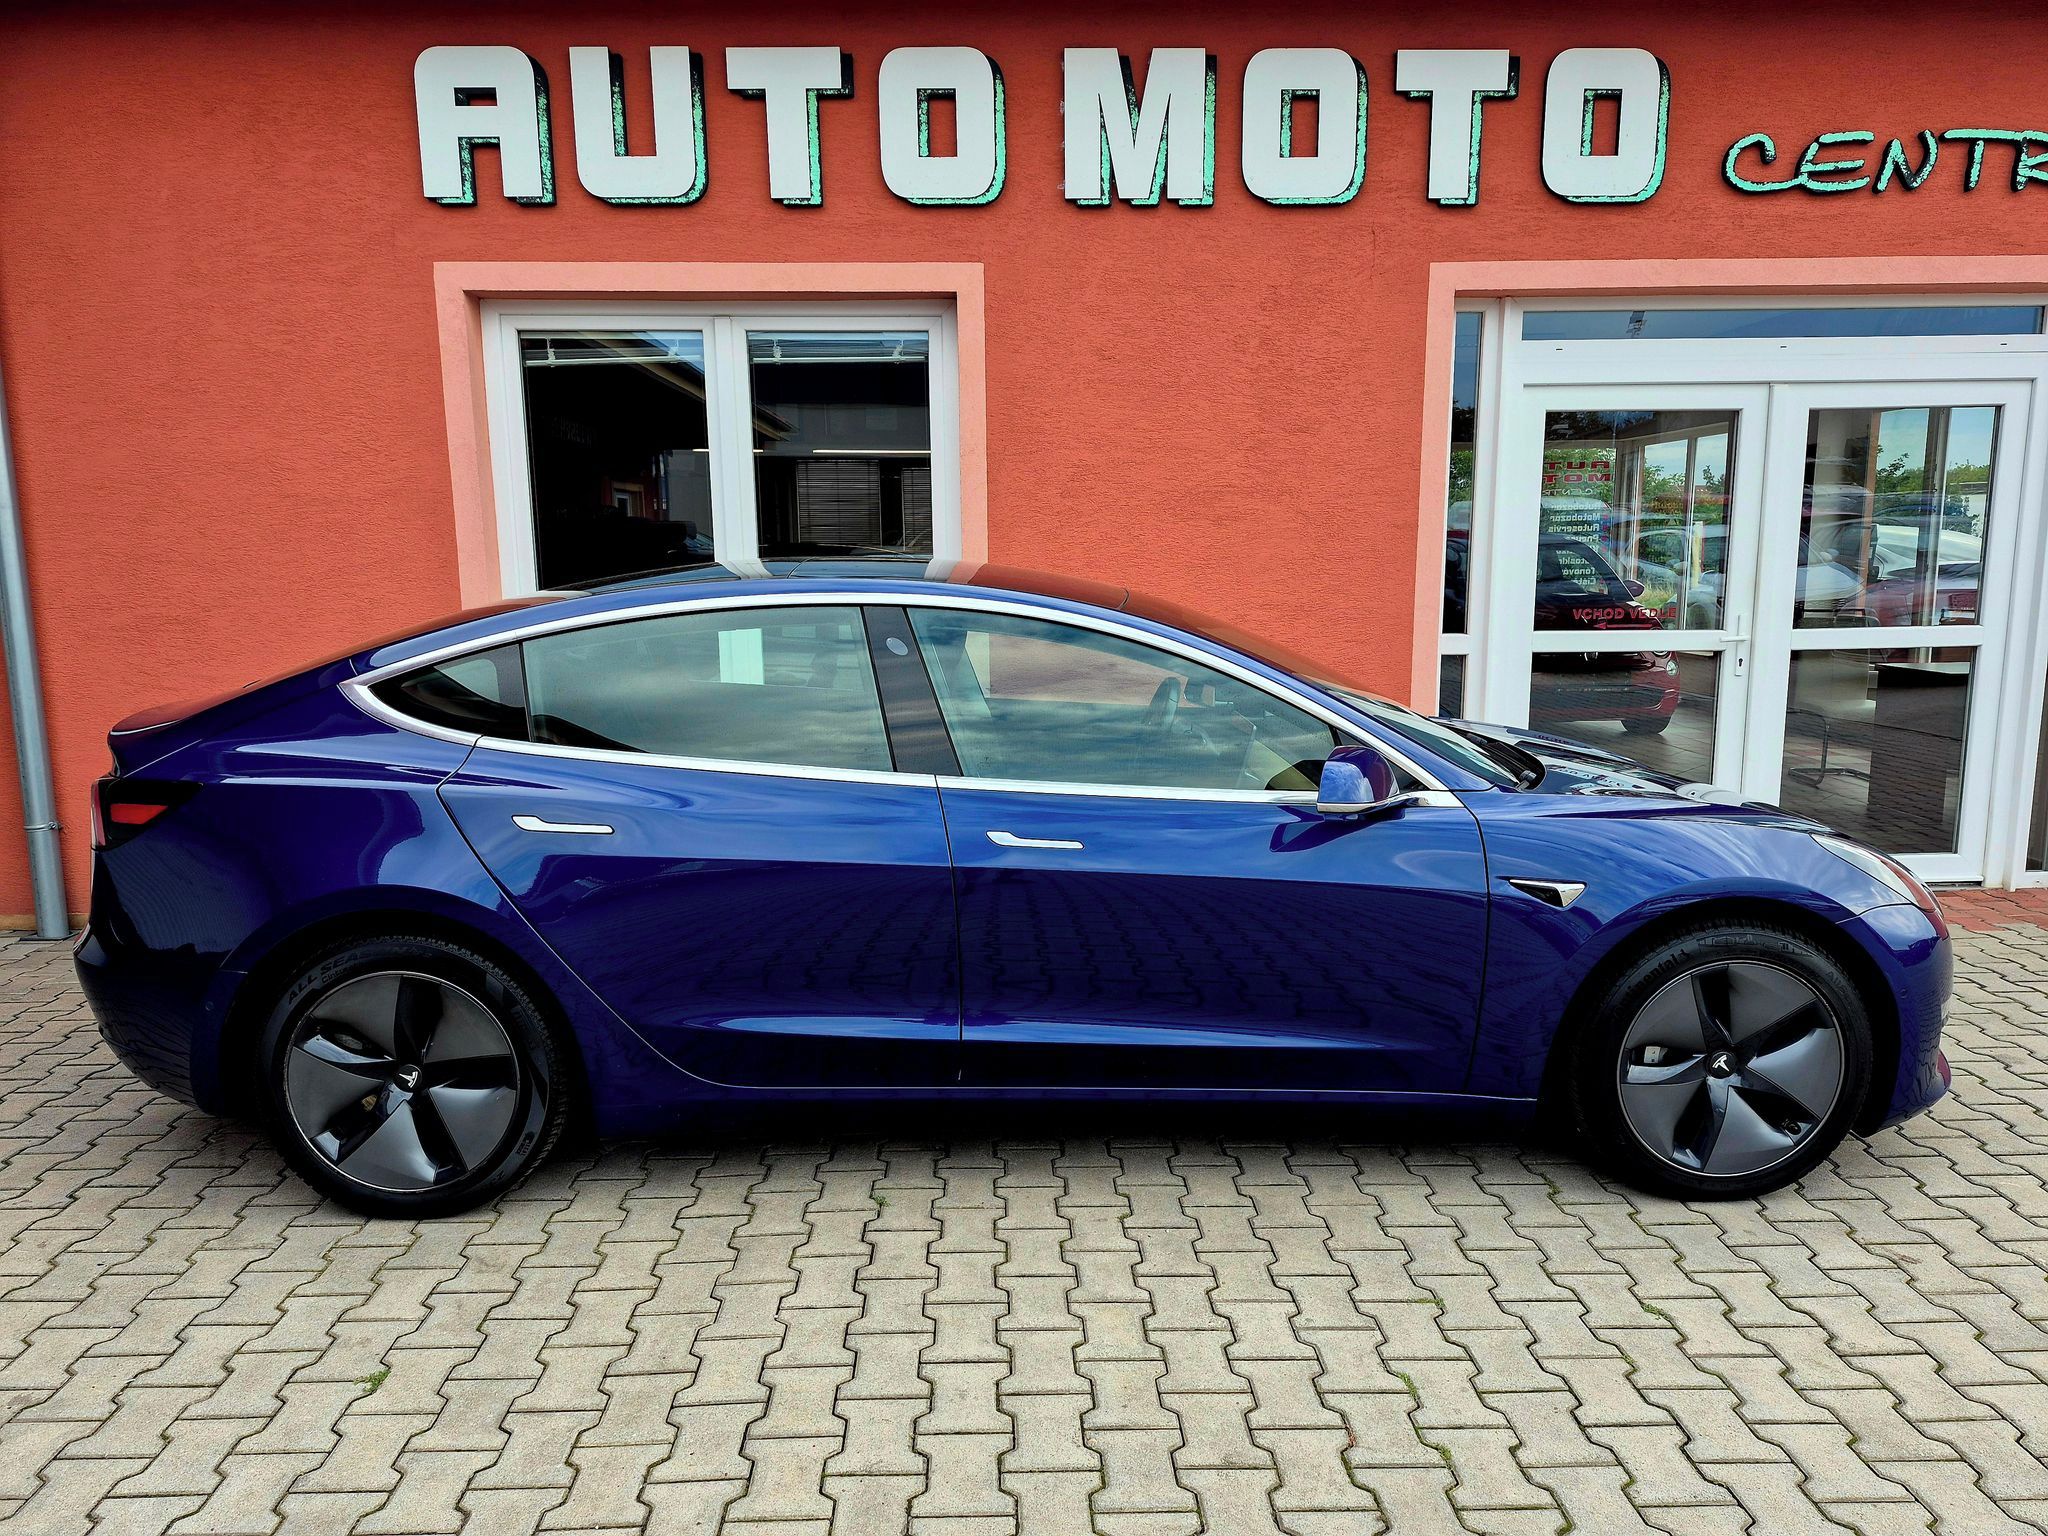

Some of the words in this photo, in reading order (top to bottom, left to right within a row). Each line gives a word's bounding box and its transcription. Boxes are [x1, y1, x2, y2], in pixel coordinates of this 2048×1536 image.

[414, 45, 1007, 207] AUTO
[1063, 46, 1672, 207] MOTO
[1572, 607, 1625, 620] VCHOD
[1629, 607, 1677, 619] VEDLE
